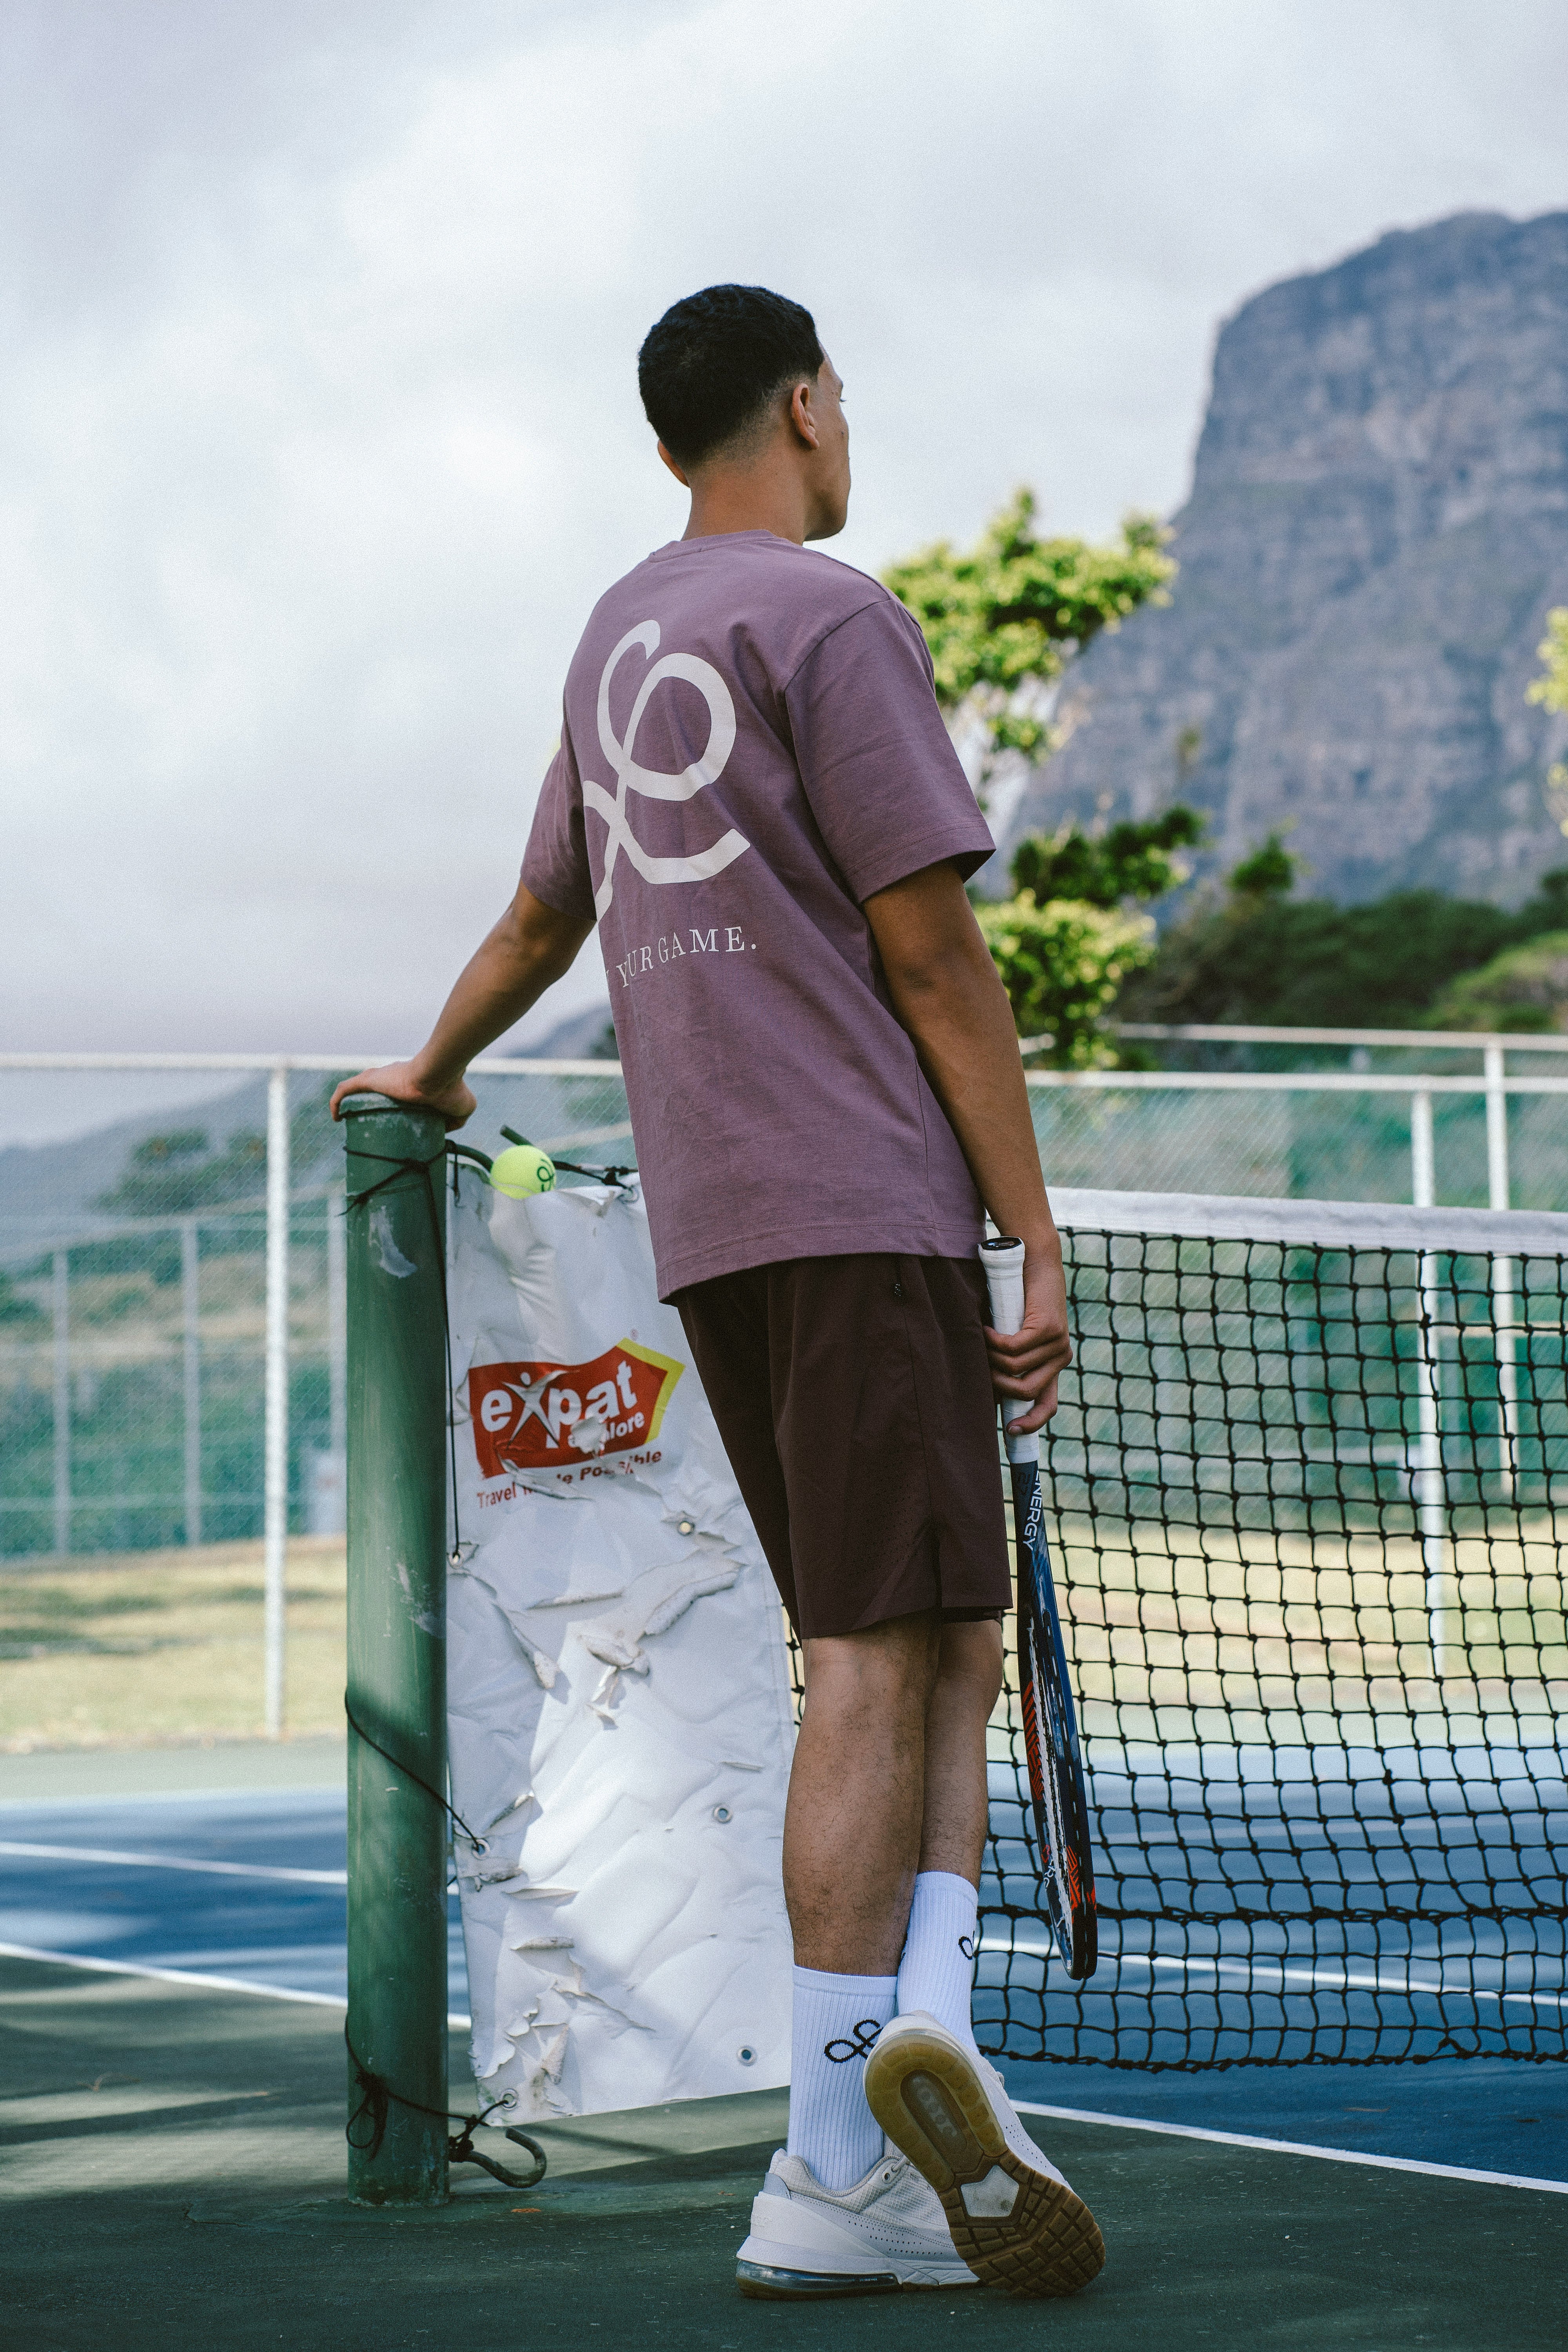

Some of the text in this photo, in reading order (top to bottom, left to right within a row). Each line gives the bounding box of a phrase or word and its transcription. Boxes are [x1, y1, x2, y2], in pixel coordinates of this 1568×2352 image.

[615, 946, 654, 988] YUR
[658, 926, 757, 964] GAME.
[567, 1411, 645, 1448] elore
[476, 1481, 517, 1509] Travel
